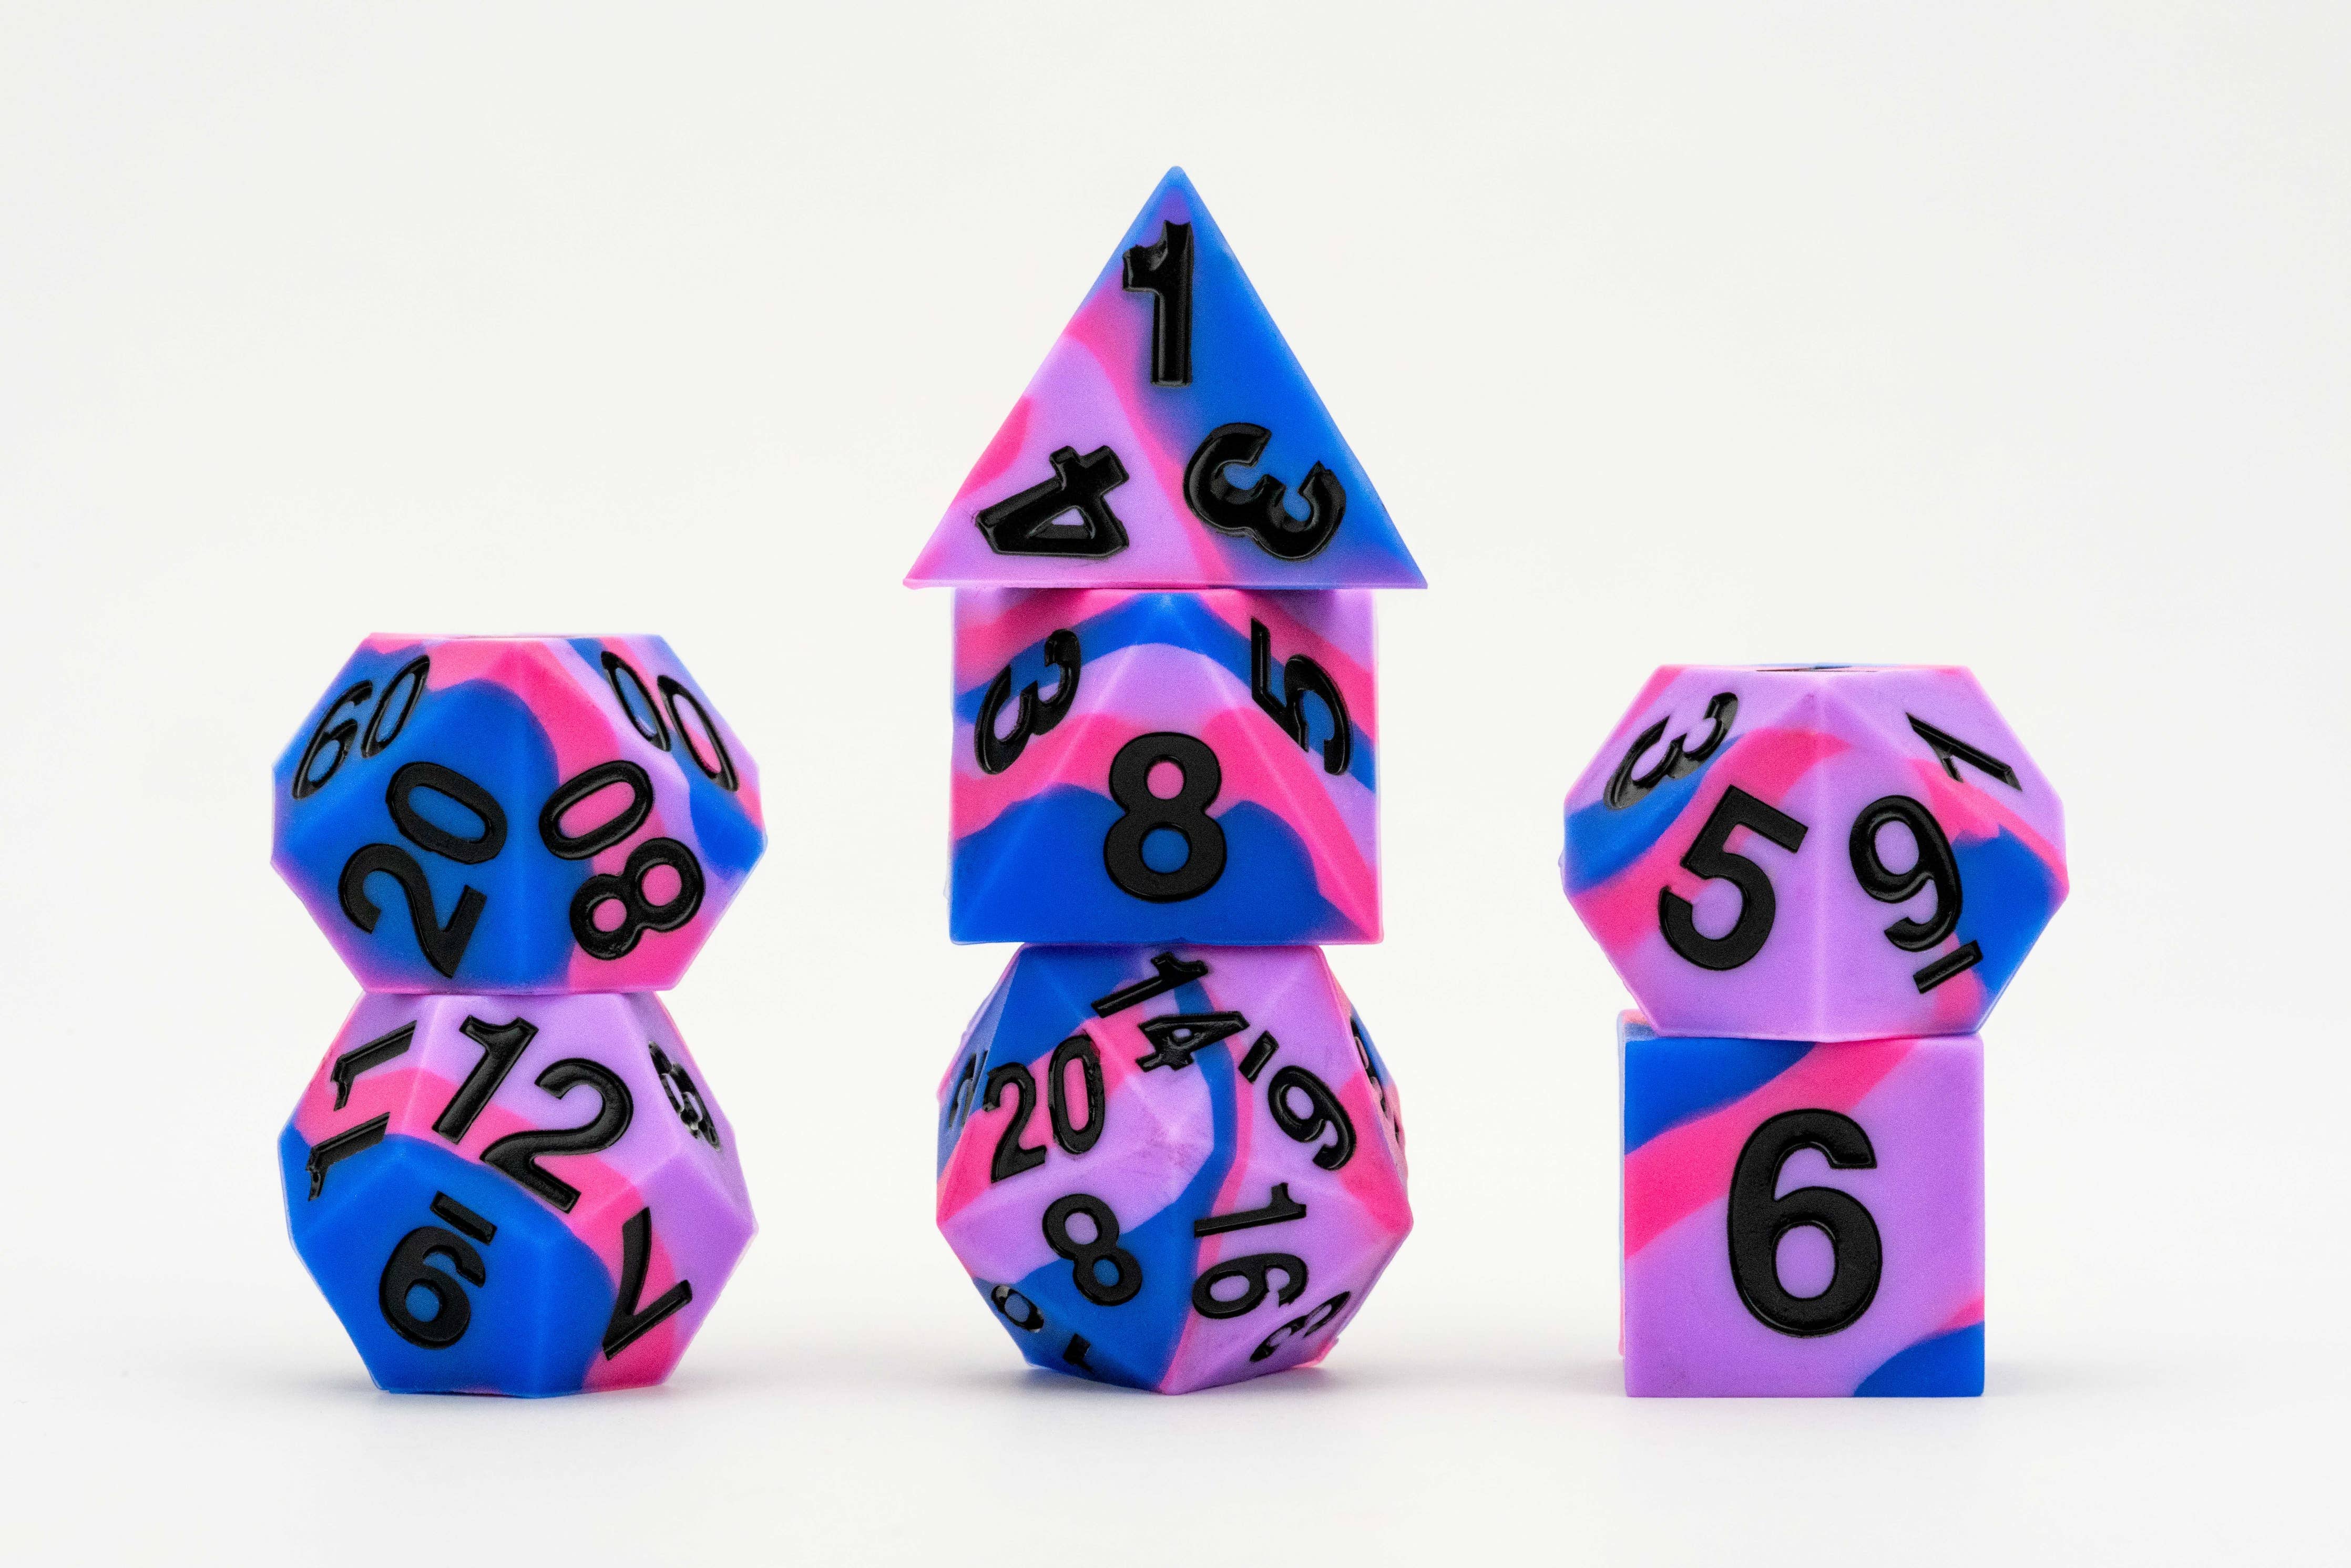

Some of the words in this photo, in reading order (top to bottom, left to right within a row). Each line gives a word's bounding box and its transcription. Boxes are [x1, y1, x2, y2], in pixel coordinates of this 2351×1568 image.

[1122, 220, 1195, 388] 1
[975, 444, 1130, 561] 4
[1182, 422, 1347, 562] 3
[292, 655, 431, 801] 60
[600, 650, 739, 793] 00
[974, 628, 1082, 776] 3
[1250, 617, 1354, 776] 5
[1603, 691, 1739, 811] 3
[1906, 712, 2022, 792] 1
[337, 761, 508, 980] 20
[537, 759, 706, 961] 80
[1102, 731, 1228, 905] 8
[1658, 783, 1809, 972] 5
[1090, 952, 1251, 1073] 14
[432, 1014, 635, 1214] 12
[982, 1032, 1107, 1184] 20
[601, 1206, 693, 1361] 7
[1041, 1193, 1143, 1307] 8
[1192, 1183, 1309, 1320] 16
[1726, 1108, 1884, 1339] 6
[1249, 1290, 1352, 1363] 3
